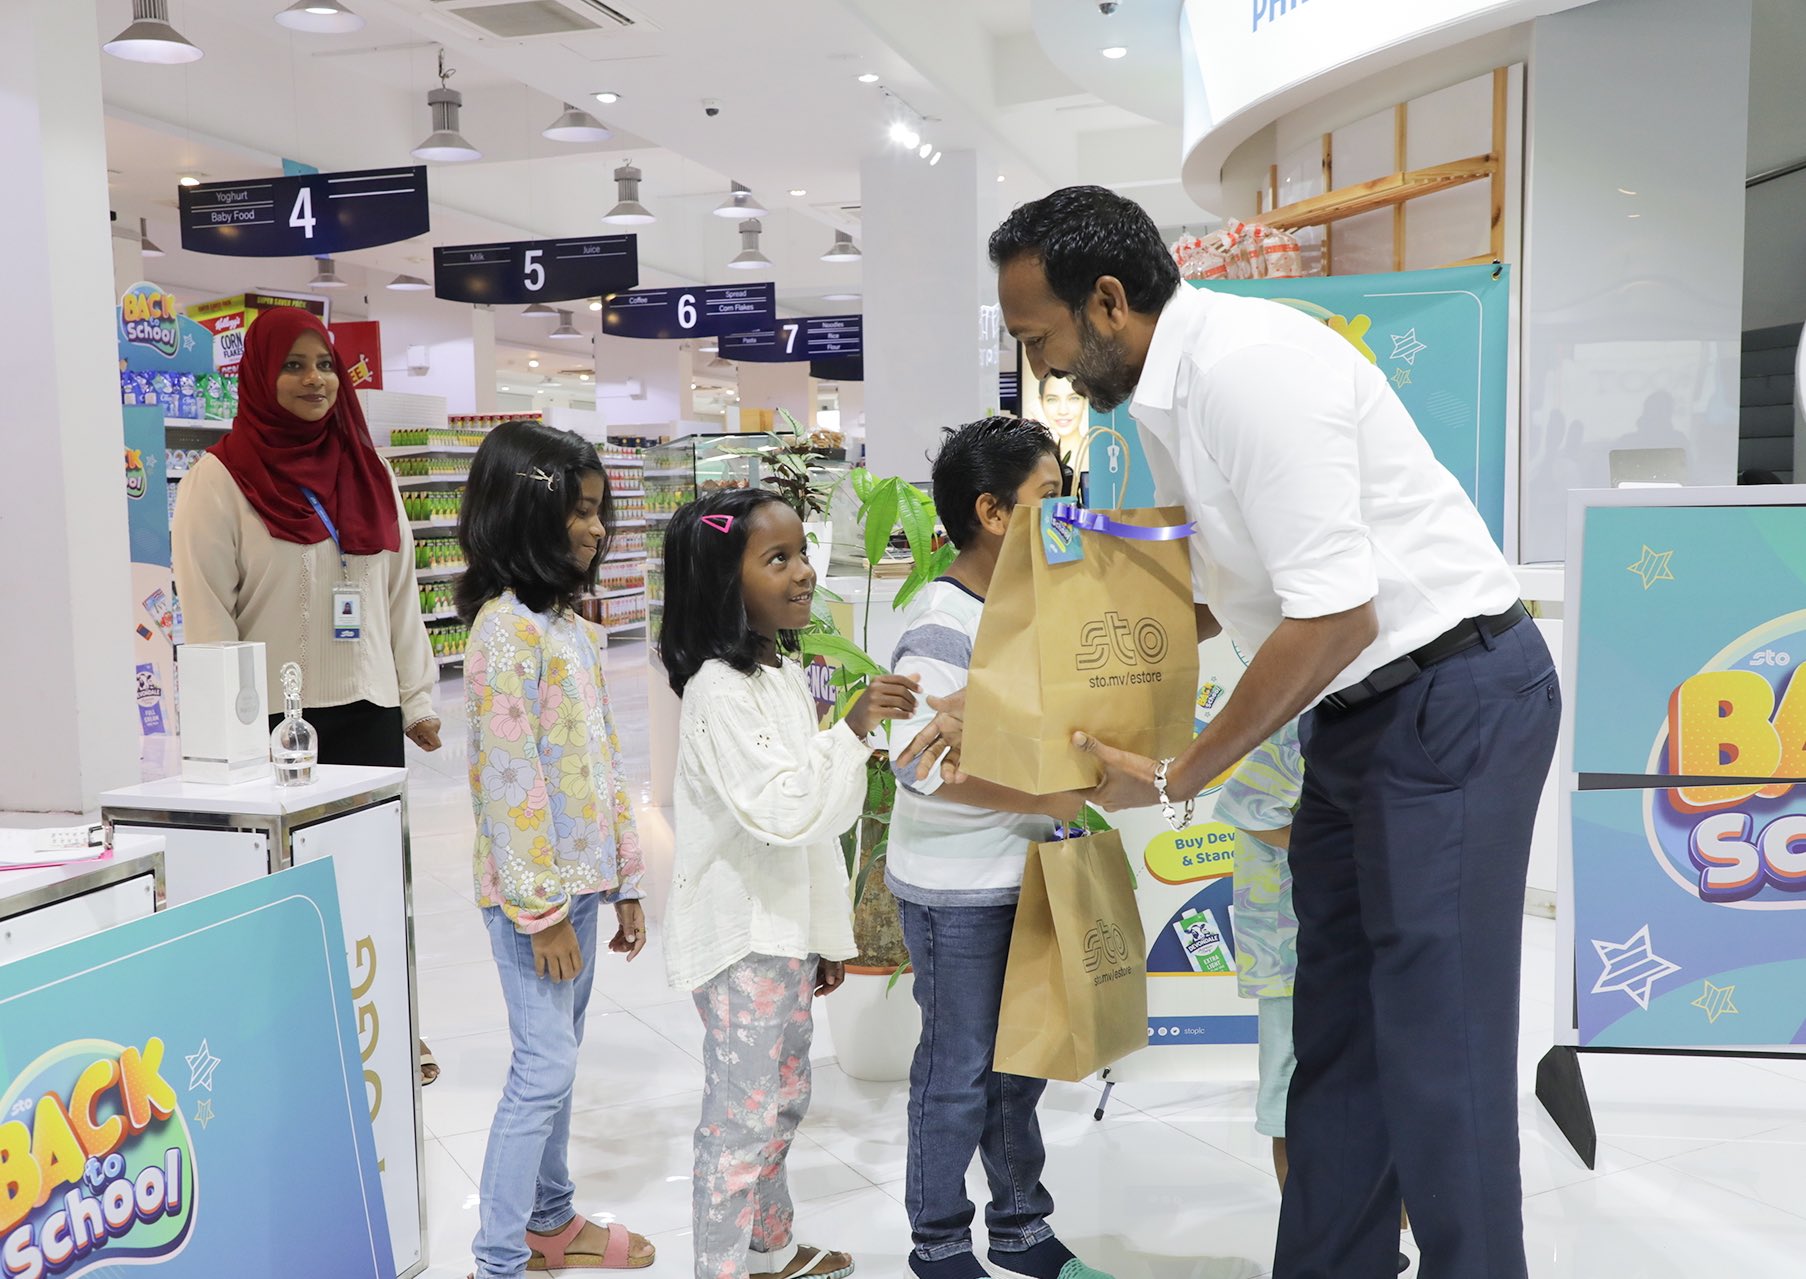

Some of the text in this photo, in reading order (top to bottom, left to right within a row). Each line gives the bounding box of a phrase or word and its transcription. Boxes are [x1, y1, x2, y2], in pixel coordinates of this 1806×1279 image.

[215, 191, 248, 203] Yoghurt
[211, 209, 255, 223] Baby Food
[289, 187, 316, 239] 4
[469, 253, 485, 261] Milk
[583, 245, 601, 254] Juice
[523, 249, 545, 291] 5
[628, 296, 648, 305] Coffee
[725, 289, 747, 299] Spread
[124, 292, 177, 321] BACK
[677, 294, 697, 329] 6
[719, 303, 754, 312] Corn Flakes
[127, 321, 175, 345] School
[220, 332, 243, 350] CORN
[783, 324, 799, 354] 7
[1076, 611, 1168, 671] sto
[1749, 649, 1791, 666] sto
[1089, 671, 1162, 689] sto.mv/estore
[1174, 832, 1235, 850] Buy Dev
[1182, 855, 1193, 867] &
[1083, 919, 1129, 973] sto
[85, 1153, 125, 1187] to
[4, 1147, 181, 1279] School
